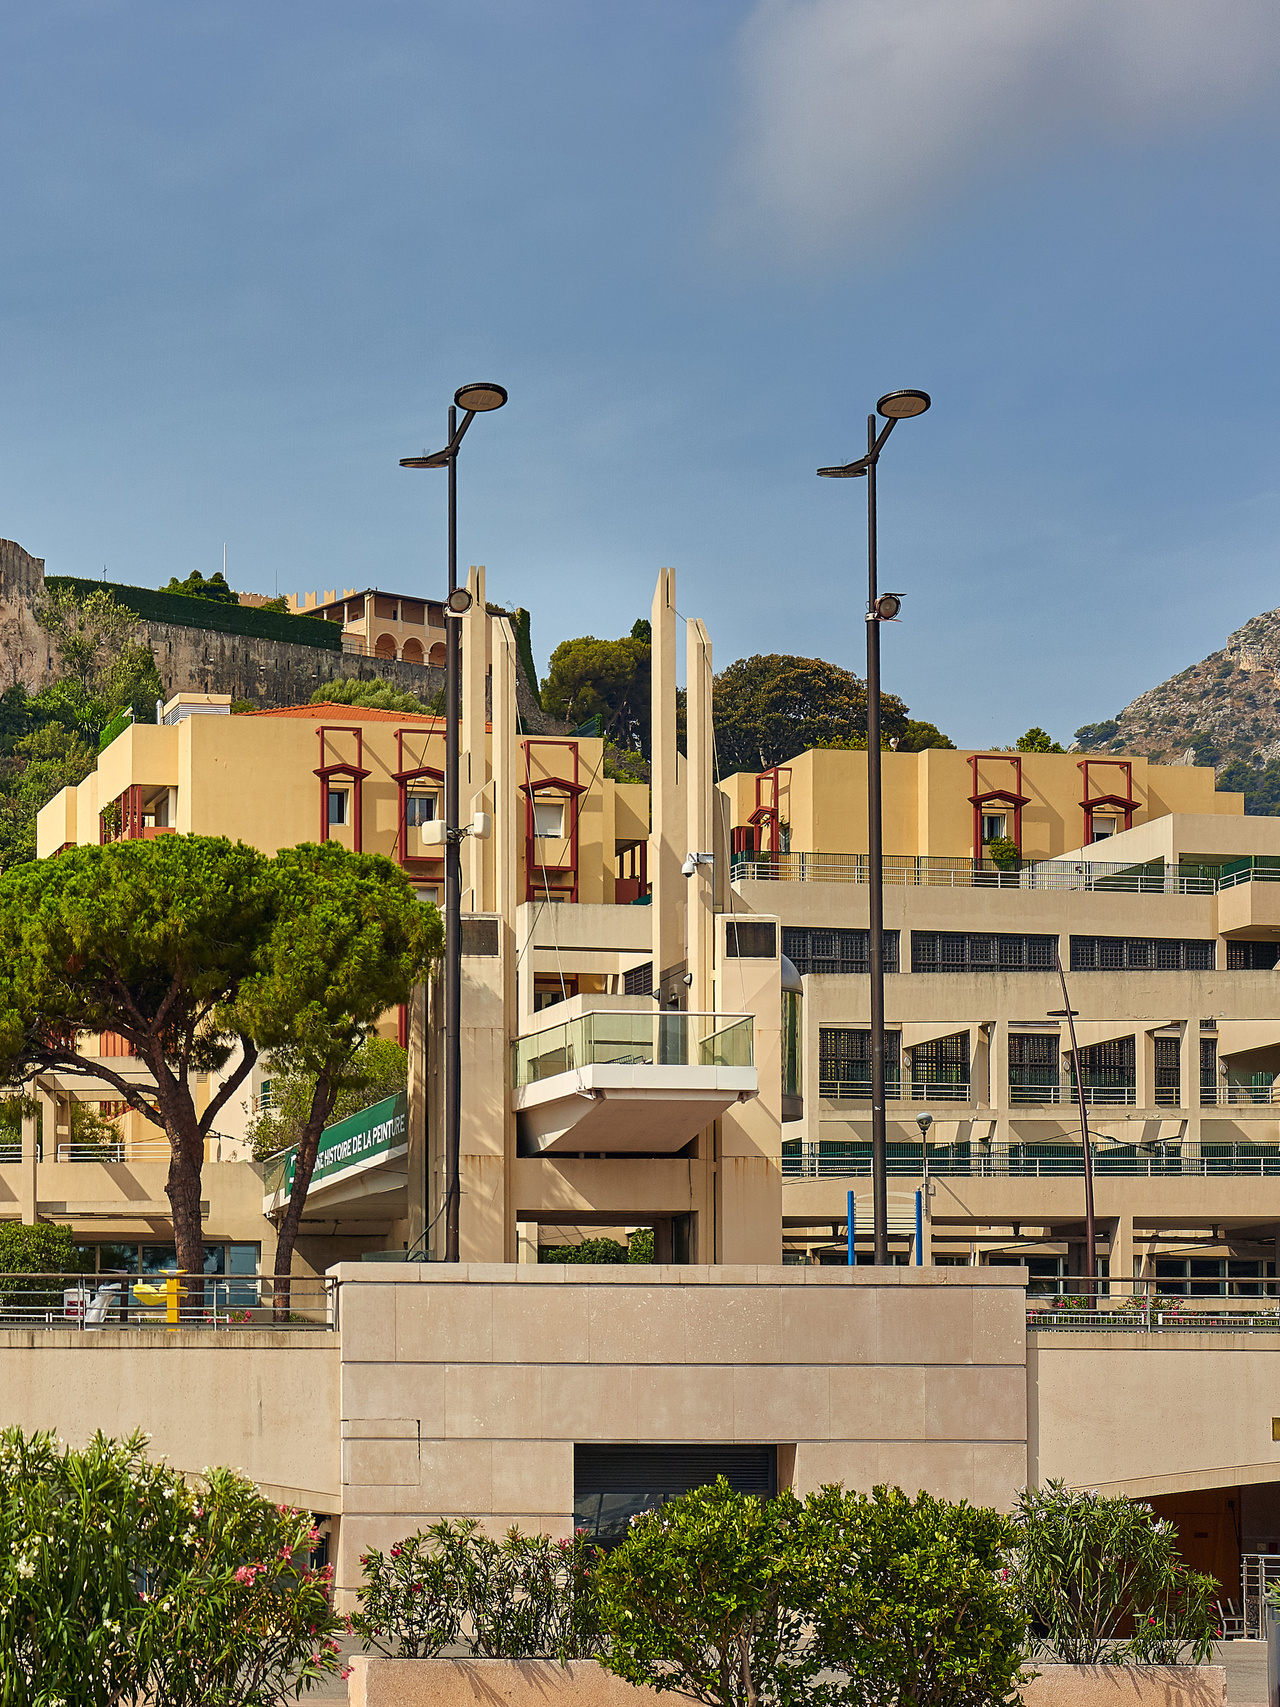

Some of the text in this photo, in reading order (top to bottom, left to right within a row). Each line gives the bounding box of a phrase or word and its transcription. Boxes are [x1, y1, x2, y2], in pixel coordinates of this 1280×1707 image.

[324, 1138, 352, 1167] HISTOIRE
[352, 1133, 362, 1154] DE
[363, 1130, 372, 1150] LA
[372, 1114, 406, 1146] PEINTURE
